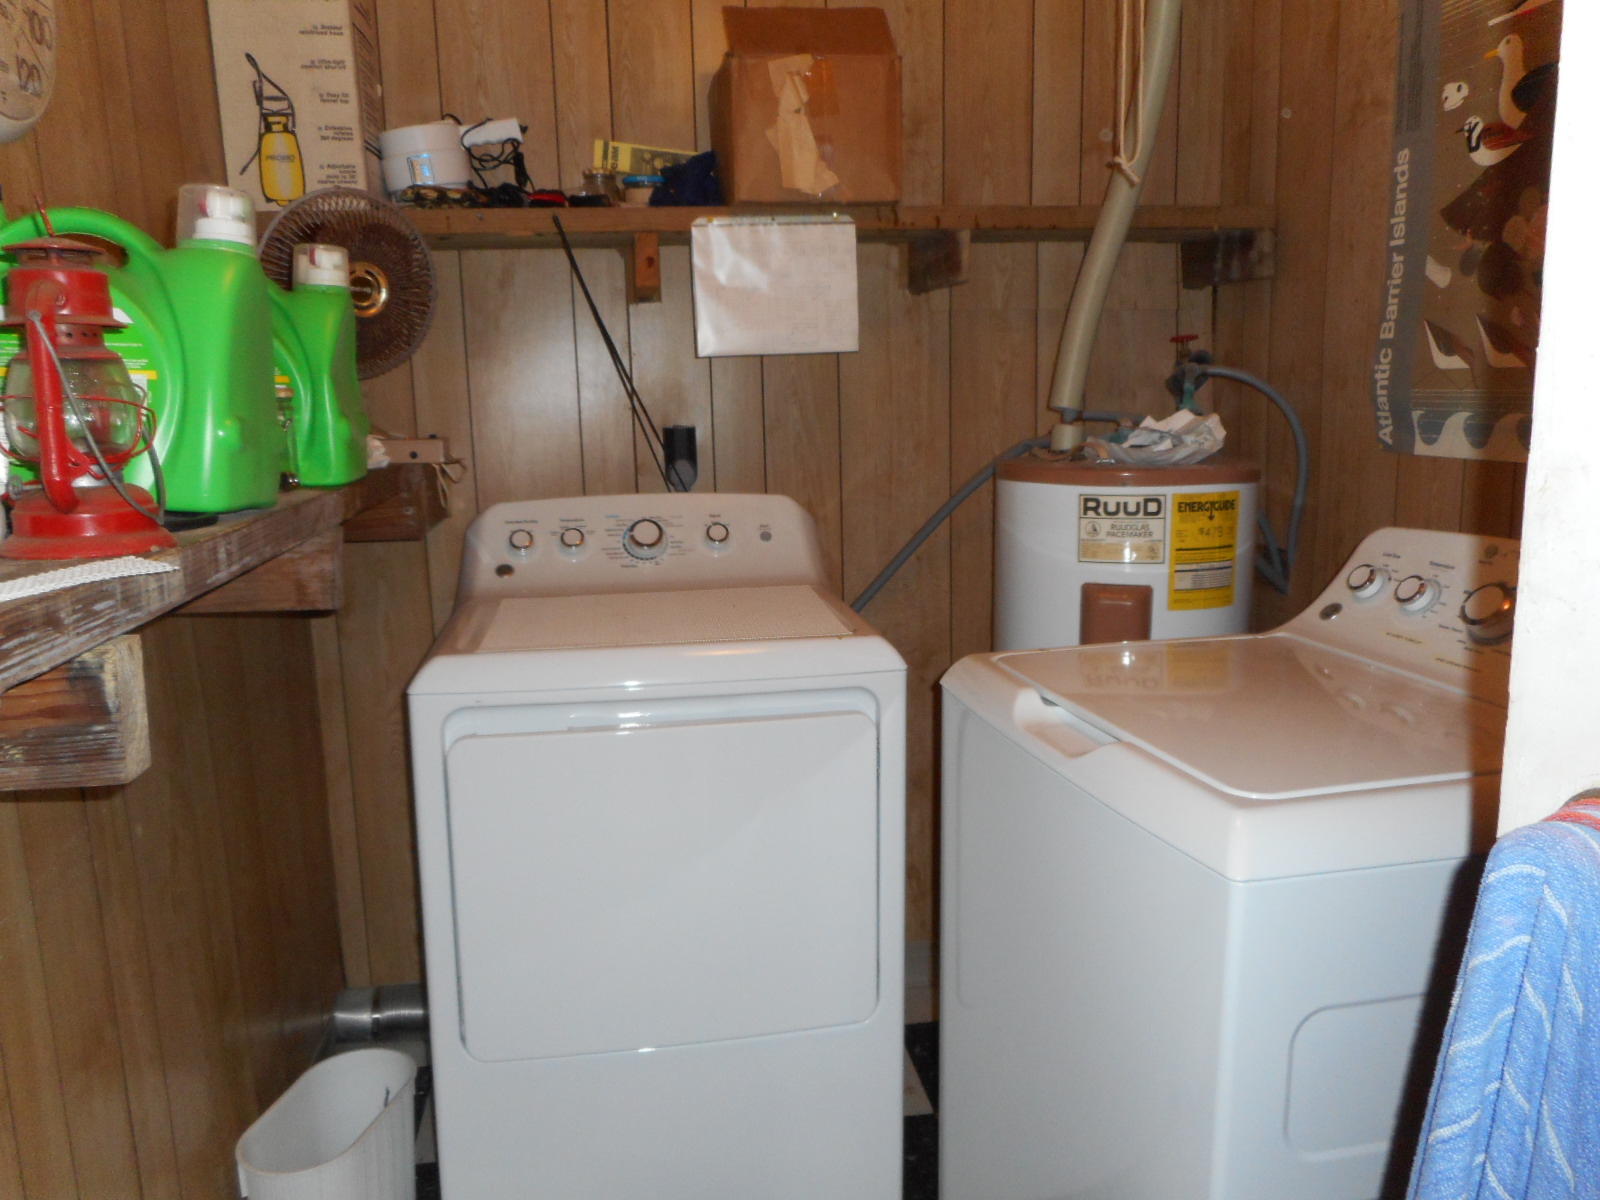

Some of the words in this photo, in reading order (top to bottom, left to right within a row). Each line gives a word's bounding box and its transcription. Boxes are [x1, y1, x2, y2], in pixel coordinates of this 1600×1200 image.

[1388, 147, 1410, 247] Islands
[1379, 251, 1404, 340] Barrier
[1374, 347, 1393, 446] Atlantic
[1082, 497, 1162, 517] RUUD
